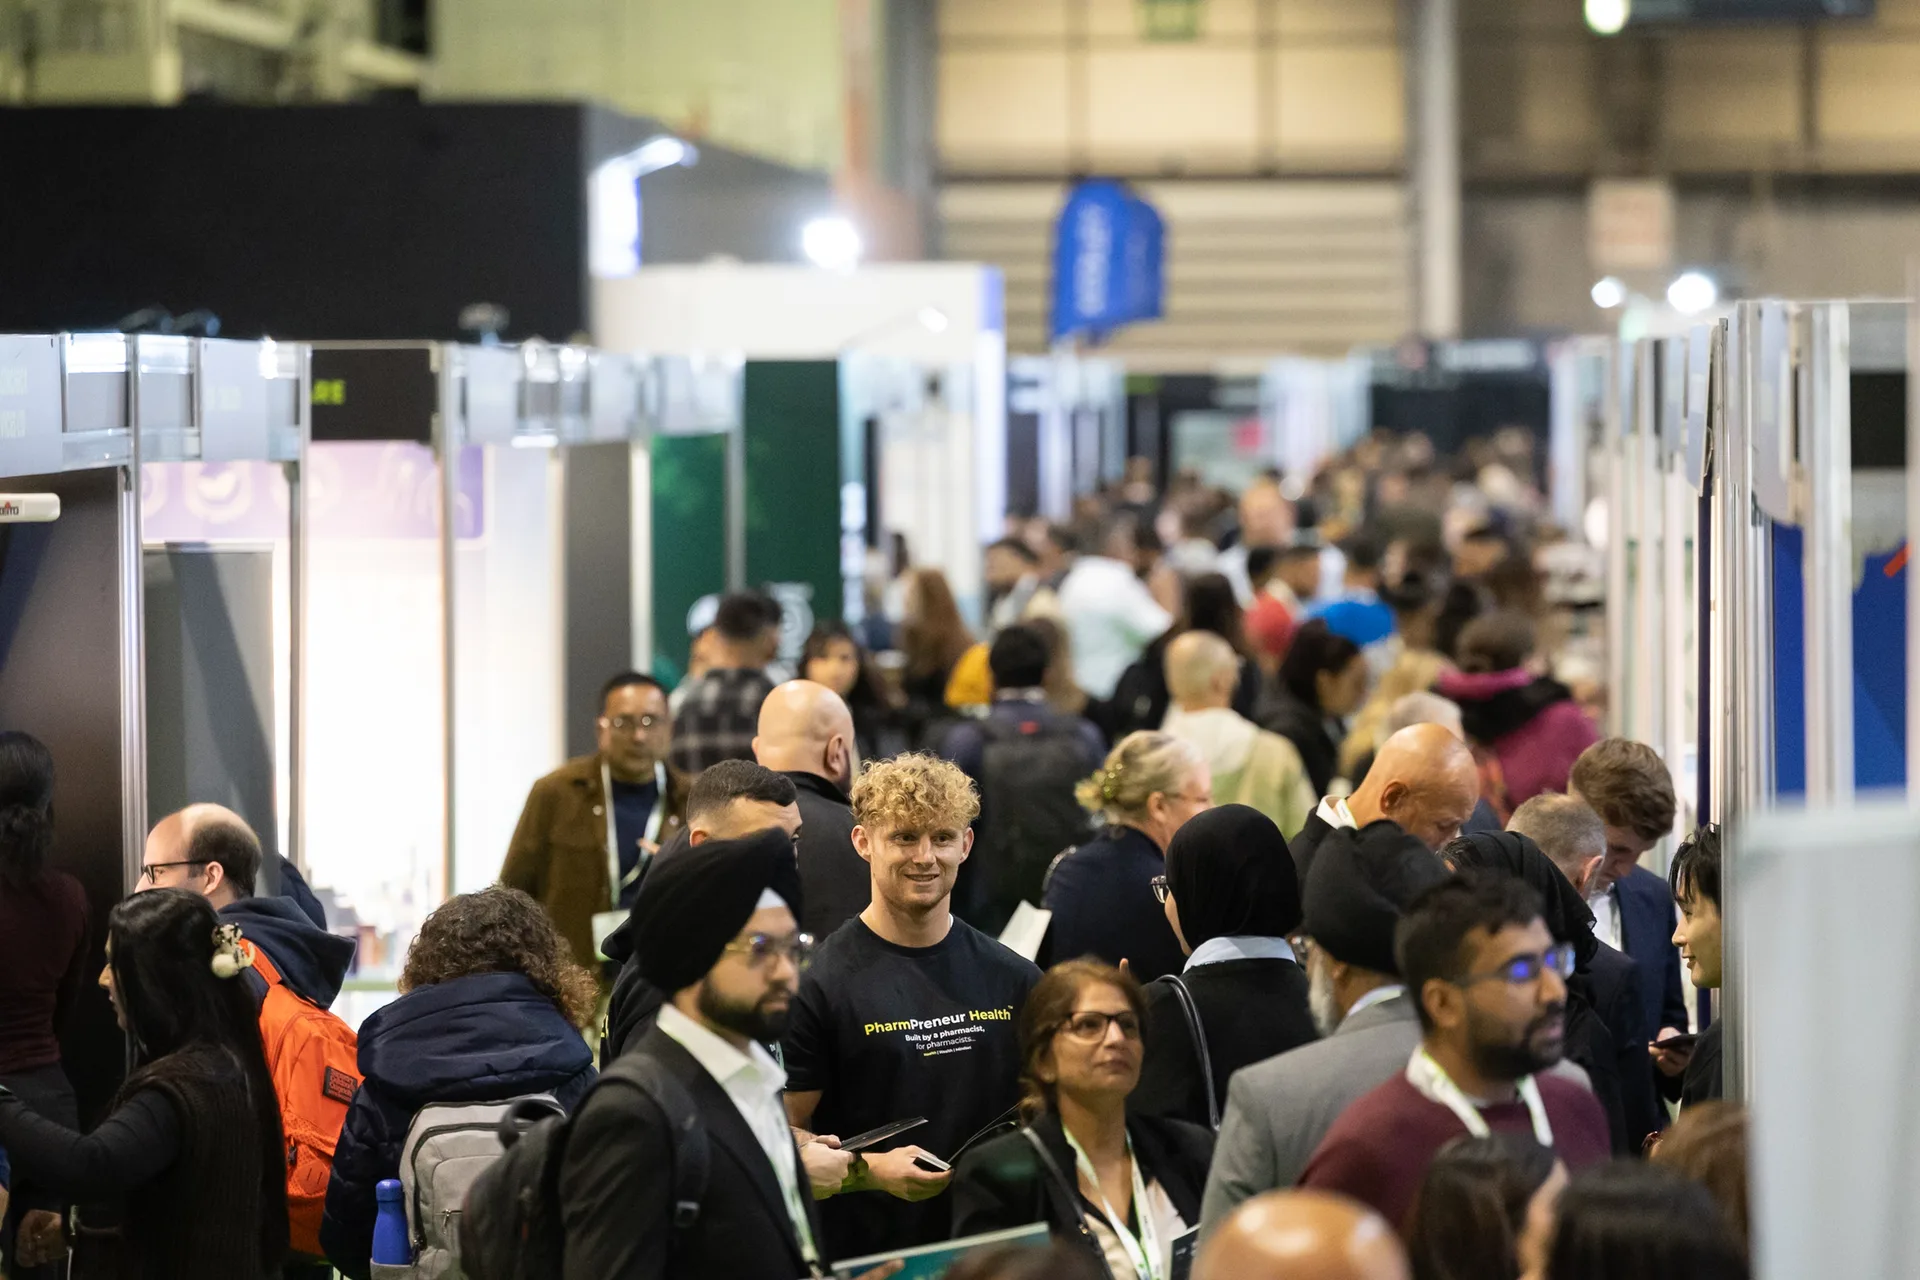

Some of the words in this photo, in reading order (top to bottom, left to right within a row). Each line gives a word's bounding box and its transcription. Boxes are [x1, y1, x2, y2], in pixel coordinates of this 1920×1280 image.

[864, 1012, 966, 1035] PharmPreneur
[905, 1033, 921, 1042] Built
[922, 1033, 932, 1041] by
[940, 1025, 985, 1039] pharmacist,
[916, 1042, 925, 1050] for
